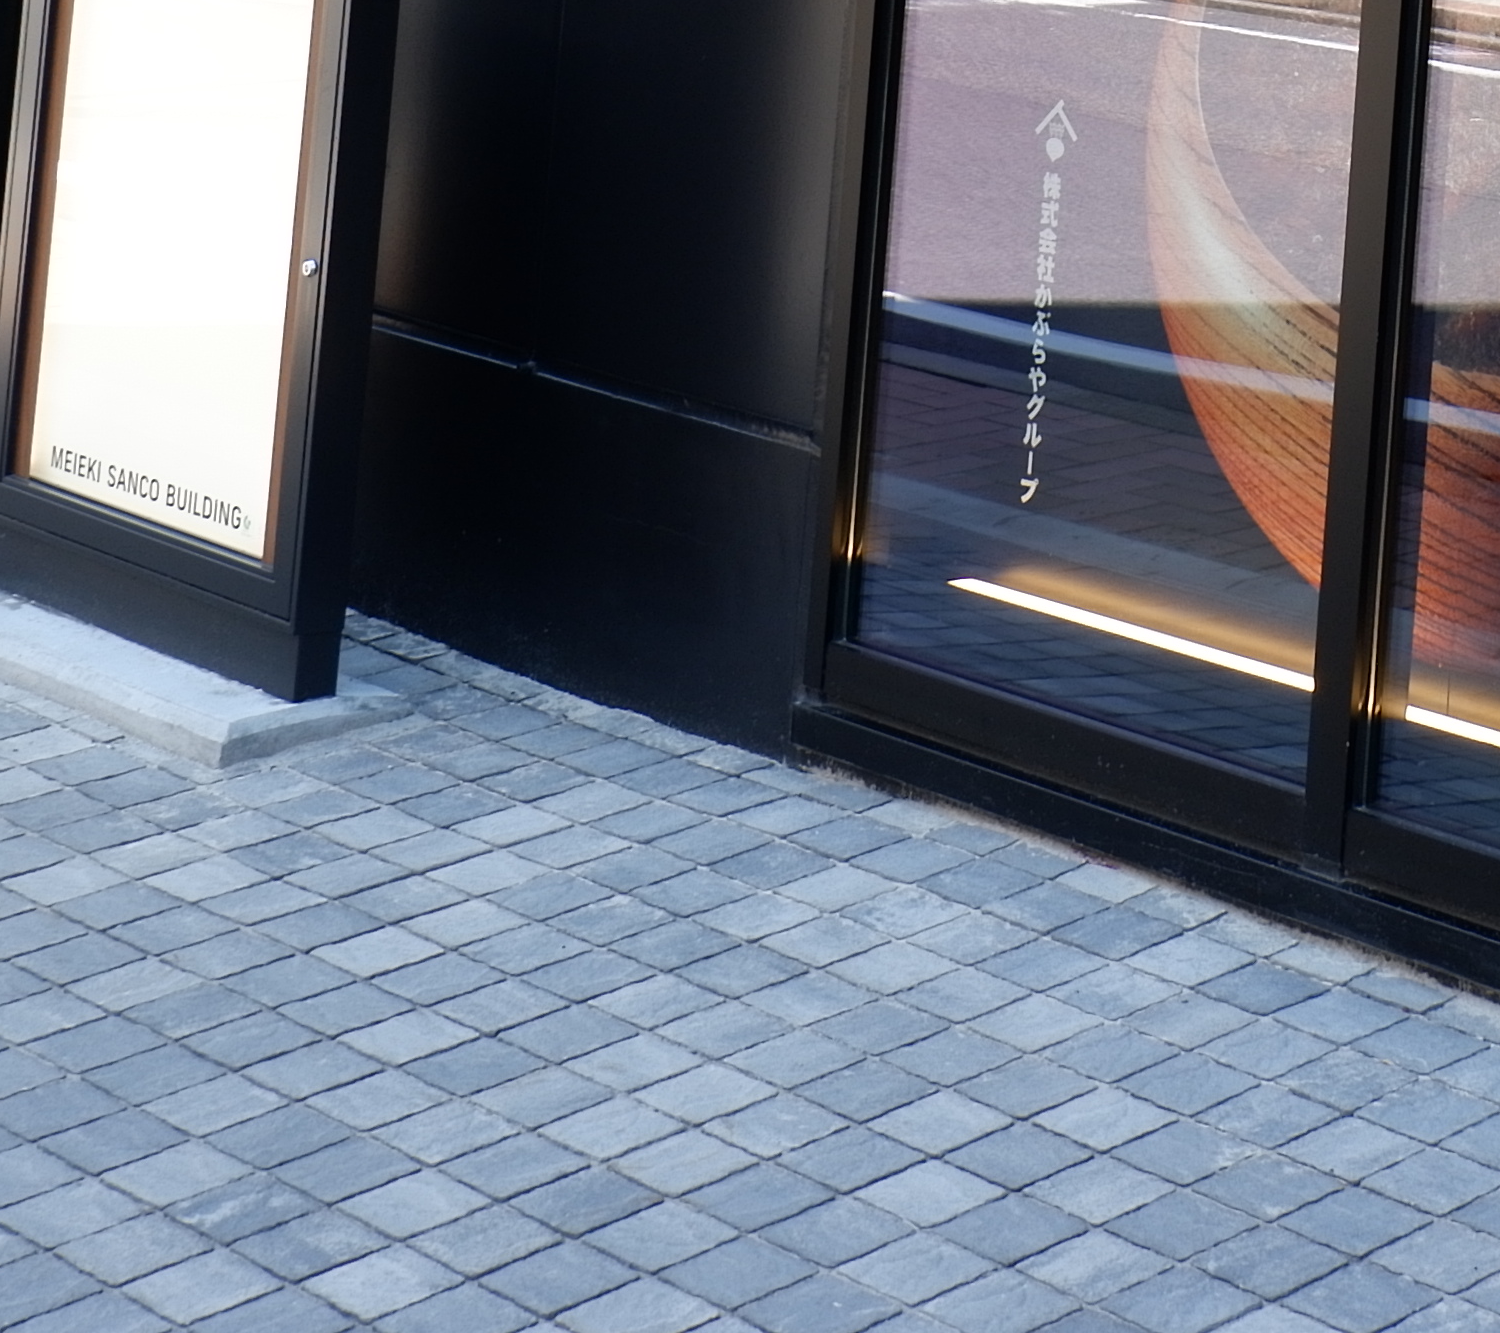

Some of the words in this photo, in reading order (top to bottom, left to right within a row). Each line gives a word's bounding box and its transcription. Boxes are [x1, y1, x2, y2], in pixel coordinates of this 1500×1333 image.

[1019, 171, 1062, 504] 株式会社かぶらやグループ
[51, 445, 101, 483] MEIEKI
[107, 464, 160, 502] SANCO
[166, 484, 242, 530] BUILDING
